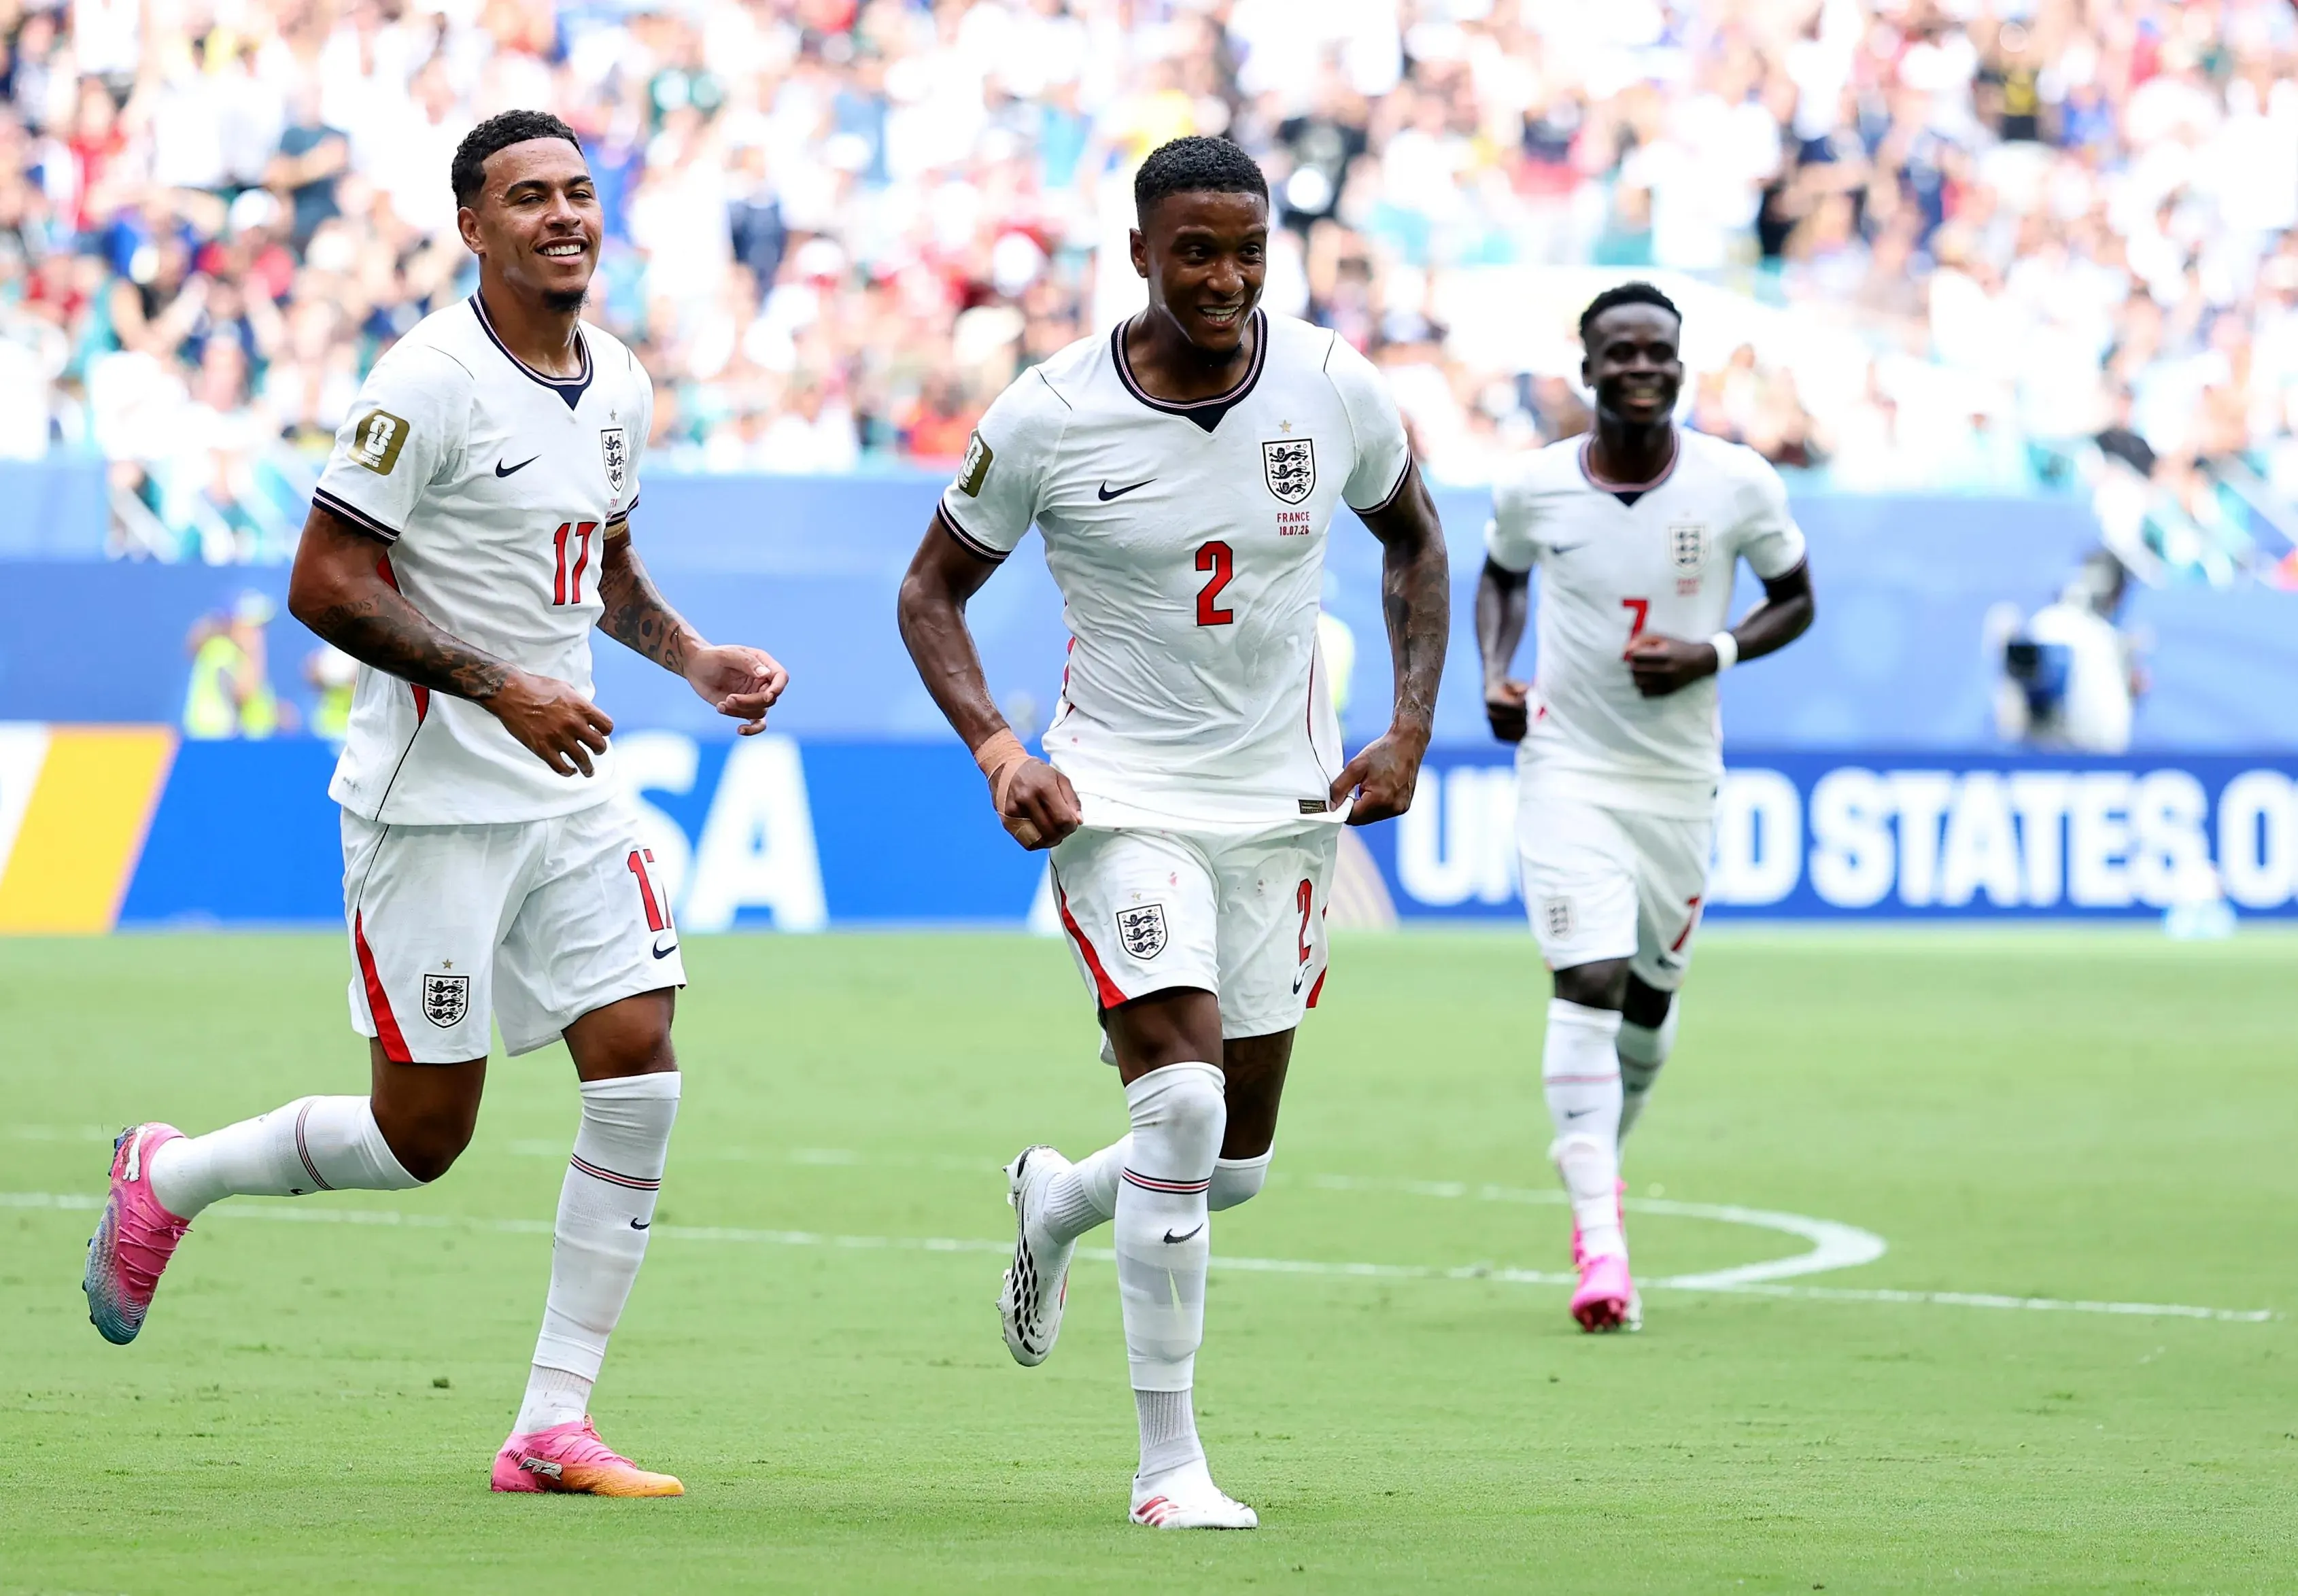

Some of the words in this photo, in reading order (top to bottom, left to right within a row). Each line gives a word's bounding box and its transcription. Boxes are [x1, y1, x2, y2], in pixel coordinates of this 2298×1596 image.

[1277, 511, 1310, 523] FRANCE
[1280, 525, 1309, 536] 18.07.26
[552, 521, 599, 606] 17
[1195, 540, 1233, 627] 2
[1623, 599, 1647, 661] 7
[612, 729, 828, 933] SA
[1810, 767, 2209, 907] STATES
[2218, 768, 2298, 909] O
[1297, 878, 1312, 967] 2
